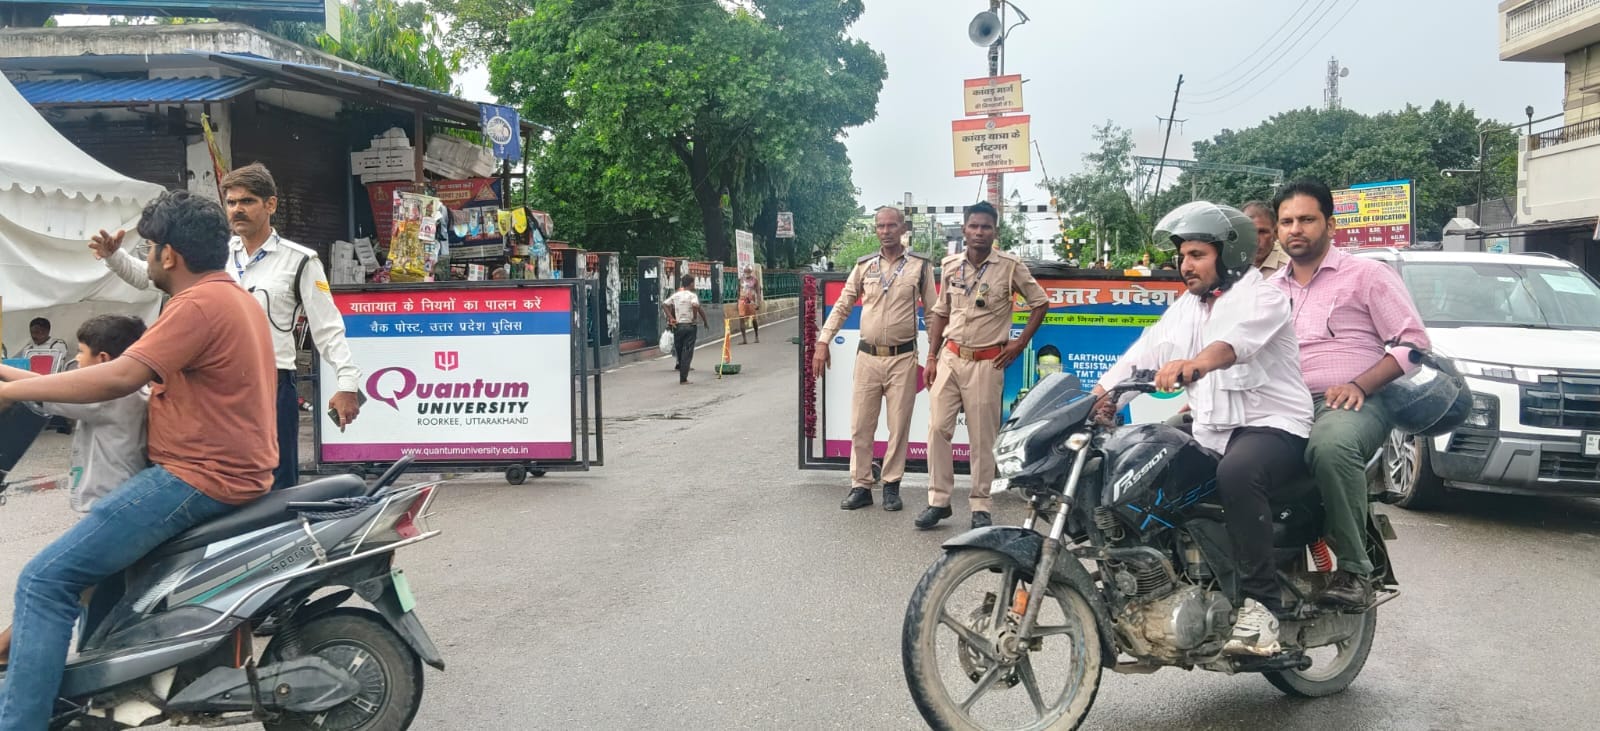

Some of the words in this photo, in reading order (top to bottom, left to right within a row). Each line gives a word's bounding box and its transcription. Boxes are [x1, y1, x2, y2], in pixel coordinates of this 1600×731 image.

[988, 133, 1009, 141] यात्रा
[1011, 130, 1020, 139] के
[1337, 216, 1361, 224] COLLEGE
[1363, 215, 1370, 223] OF
[1046, 287, 1100, 305] उत्तर
[1110, 284, 1179, 306] प्रदेश
[350, 301, 397, 313] यातायात
[403, 298, 414, 312] के
[421, 297, 457, 312] नियमों
[464, 299, 478, 312] का
[485, 298, 517, 311] पालन
[523, 296, 541, 309] करें
[370, 320, 389, 333] चैक
[394, 319, 424, 334] पोस्ट,
[429, 321, 454, 333] उत्तर
[459, 319, 486, 332] प्रदेश
[492, 318, 523, 334] पुलिस
[1042, 315, 1064, 325] ुरक्षा
[1073, 361, 1114, 370] RESISTAN
[1076, 370, 1095, 378] TMT
[365, 366, 529, 411] Quantum
[417, 400, 530, 415] UNIVERSITY
[417, 416, 463, 427] ROORKEE,
[465, 415, 529, 426] UTTARAKHAND
[400, 445, 529, 457] www.quantumuniversity.edu.in
